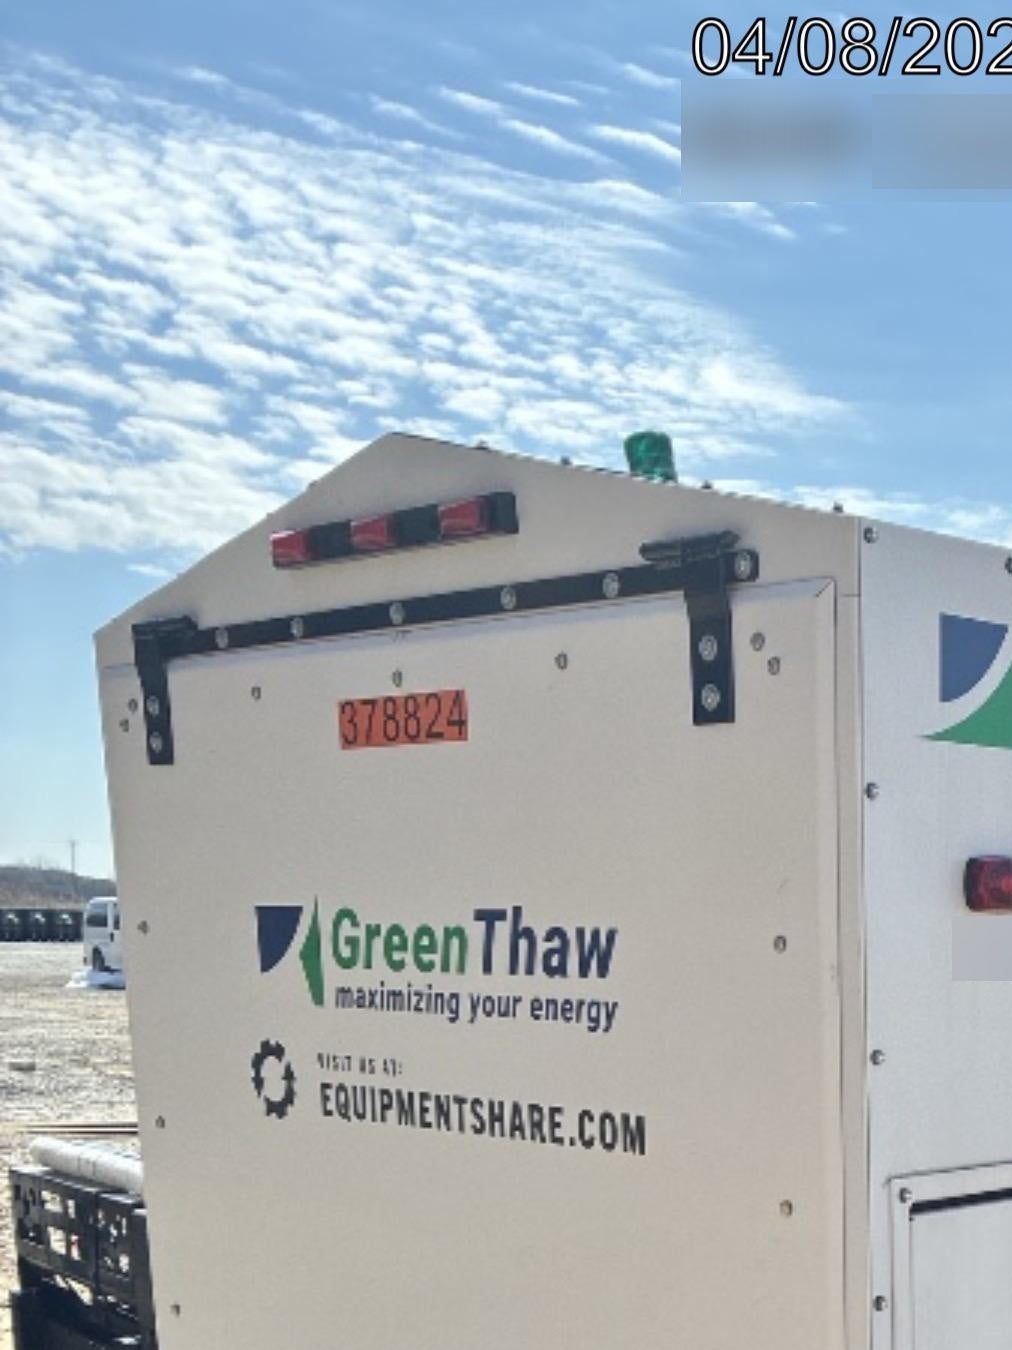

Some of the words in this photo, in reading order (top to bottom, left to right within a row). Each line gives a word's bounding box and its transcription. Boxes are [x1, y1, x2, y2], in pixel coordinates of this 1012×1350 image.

[340, 691, 466, 745] 378824
[331, 906, 619, 979] GreenThaw
[335, 981, 460, 1024] maximizing
[469, 991, 523, 1024] your
[530, 998, 619, 1033] energy
[319, 1082, 647, 1156] EQUIPMENTSHARE.COM
